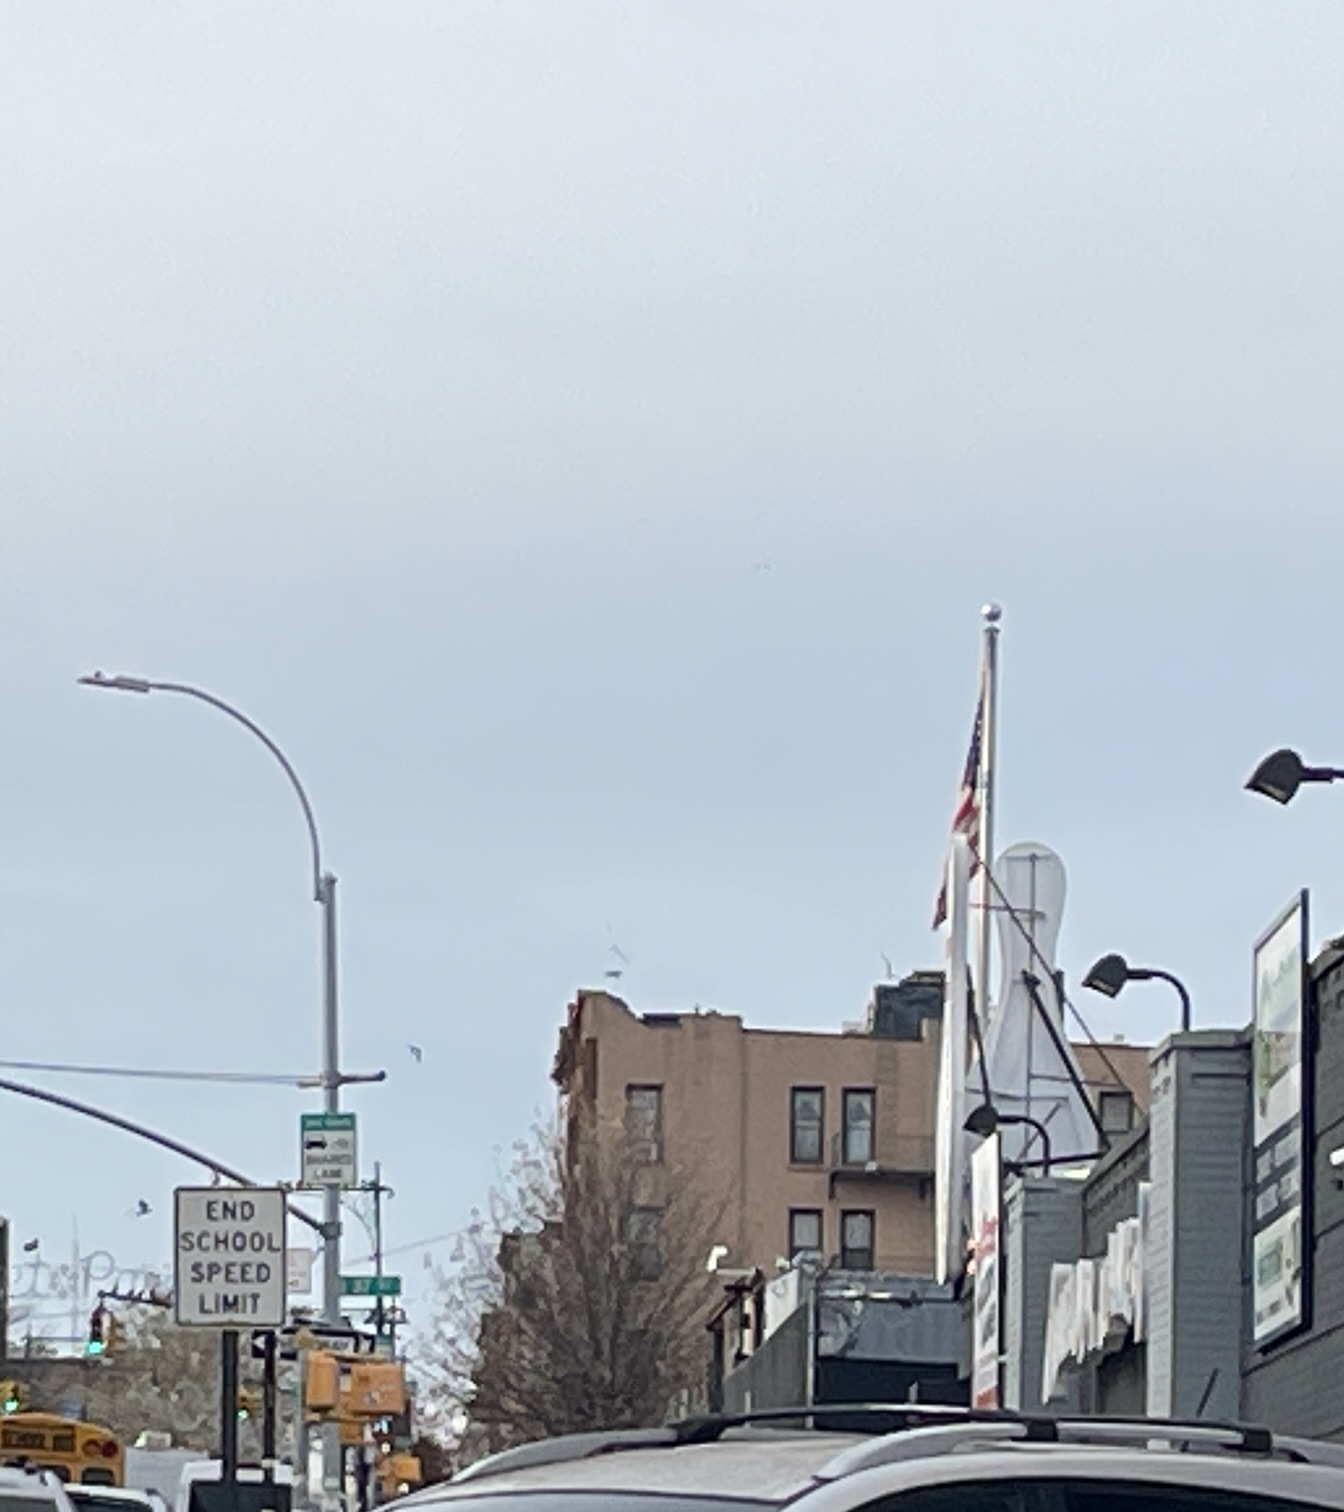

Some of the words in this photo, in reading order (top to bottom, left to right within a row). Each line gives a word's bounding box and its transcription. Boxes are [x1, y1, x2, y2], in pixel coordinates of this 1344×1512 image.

[206, 1200, 256, 1222] END
[179, 1231, 282, 1253] SCHOOL
[190, 1261, 271, 1284] SPEED
[198, 1292, 261, 1315] LIMIT
